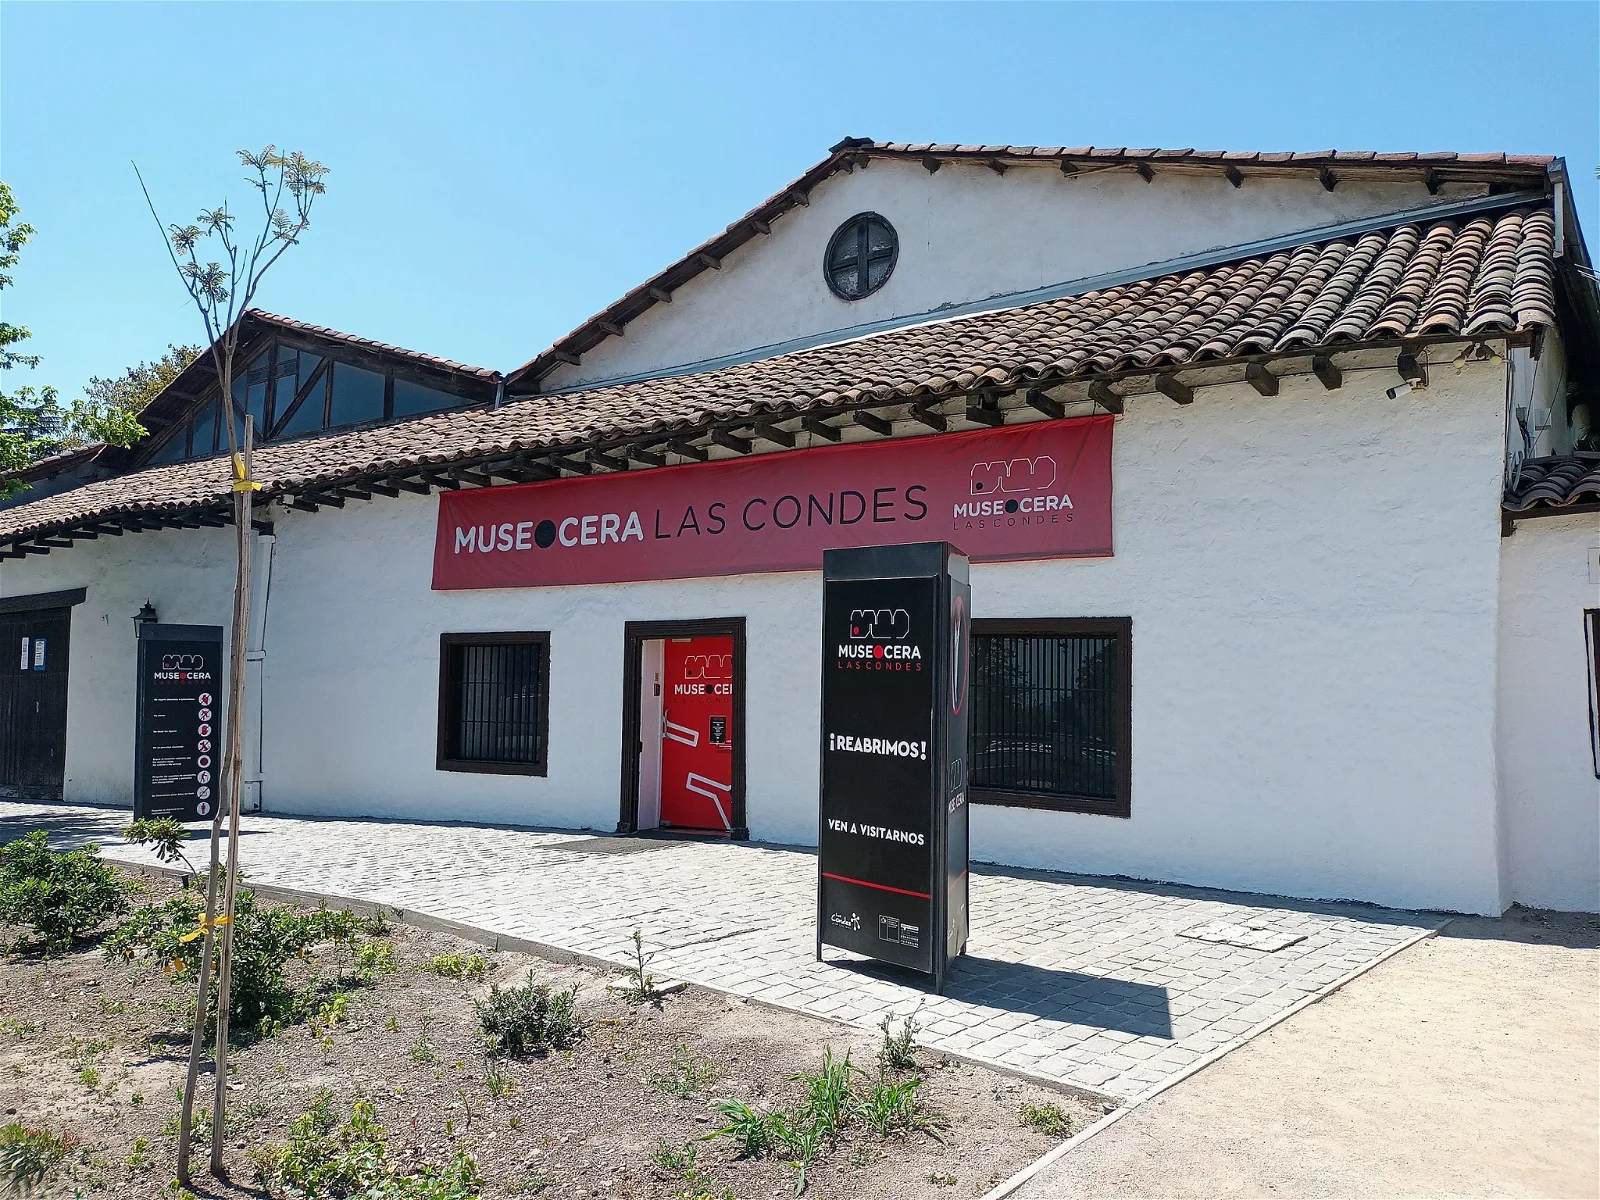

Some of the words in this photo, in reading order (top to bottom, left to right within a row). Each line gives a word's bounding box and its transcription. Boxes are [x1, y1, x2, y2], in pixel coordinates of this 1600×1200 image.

[655, 502, 726, 540] LAS
[742, 484, 928, 532] CONDES
[866, 661, 922, 672] CONDES
[829, 732, 927, 761] ¡REABRIMOS!
[828, 818, 848, 833] VEN
[850, 822, 857, 835] A
[860, 823, 925, 846] VISITARNOS
